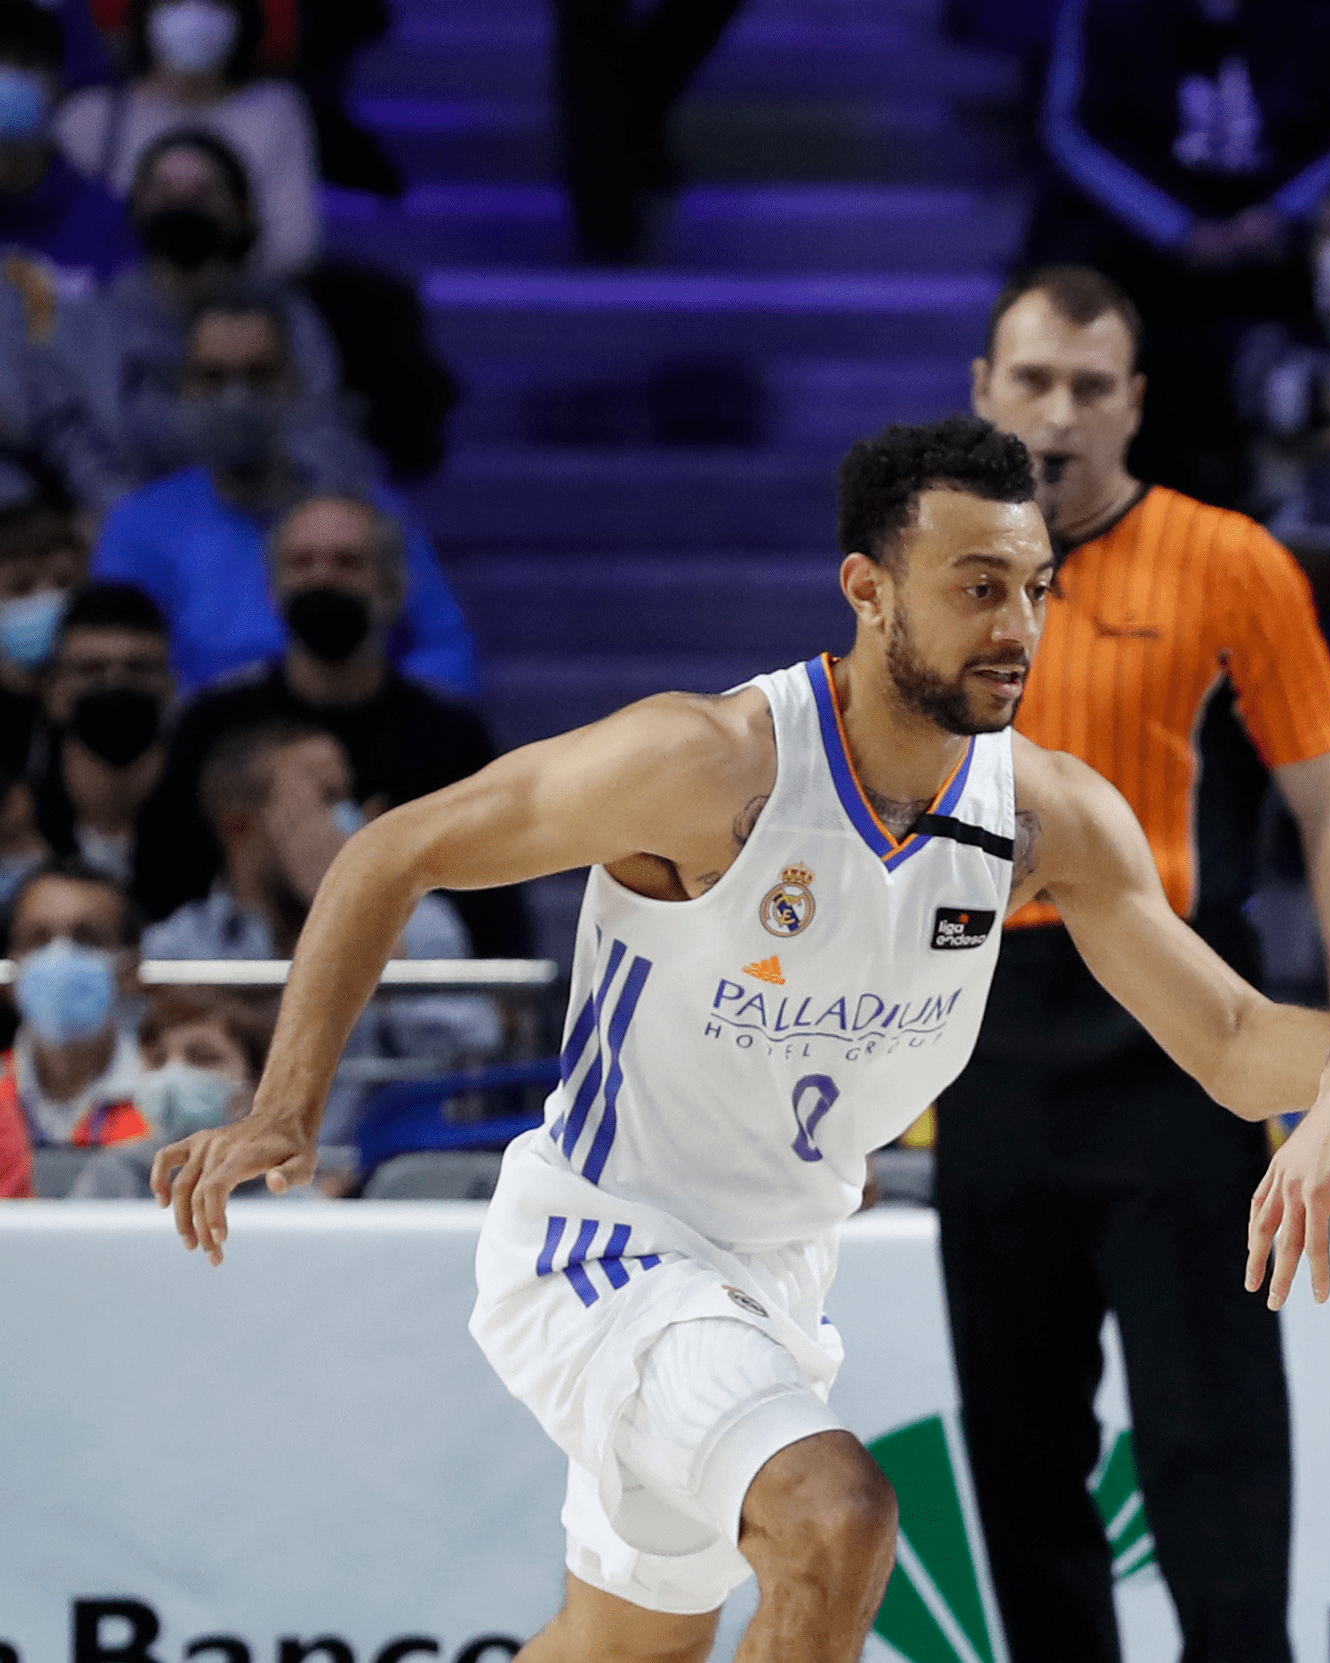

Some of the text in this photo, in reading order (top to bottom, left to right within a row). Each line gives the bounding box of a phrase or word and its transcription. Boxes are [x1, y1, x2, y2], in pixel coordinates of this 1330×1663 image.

[938, 919, 965, 935] liga
[936, 934, 986, 946] endesa
[713, 979, 963, 1032] PALLADIUM
[845, 1032, 942, 1061] GRU
